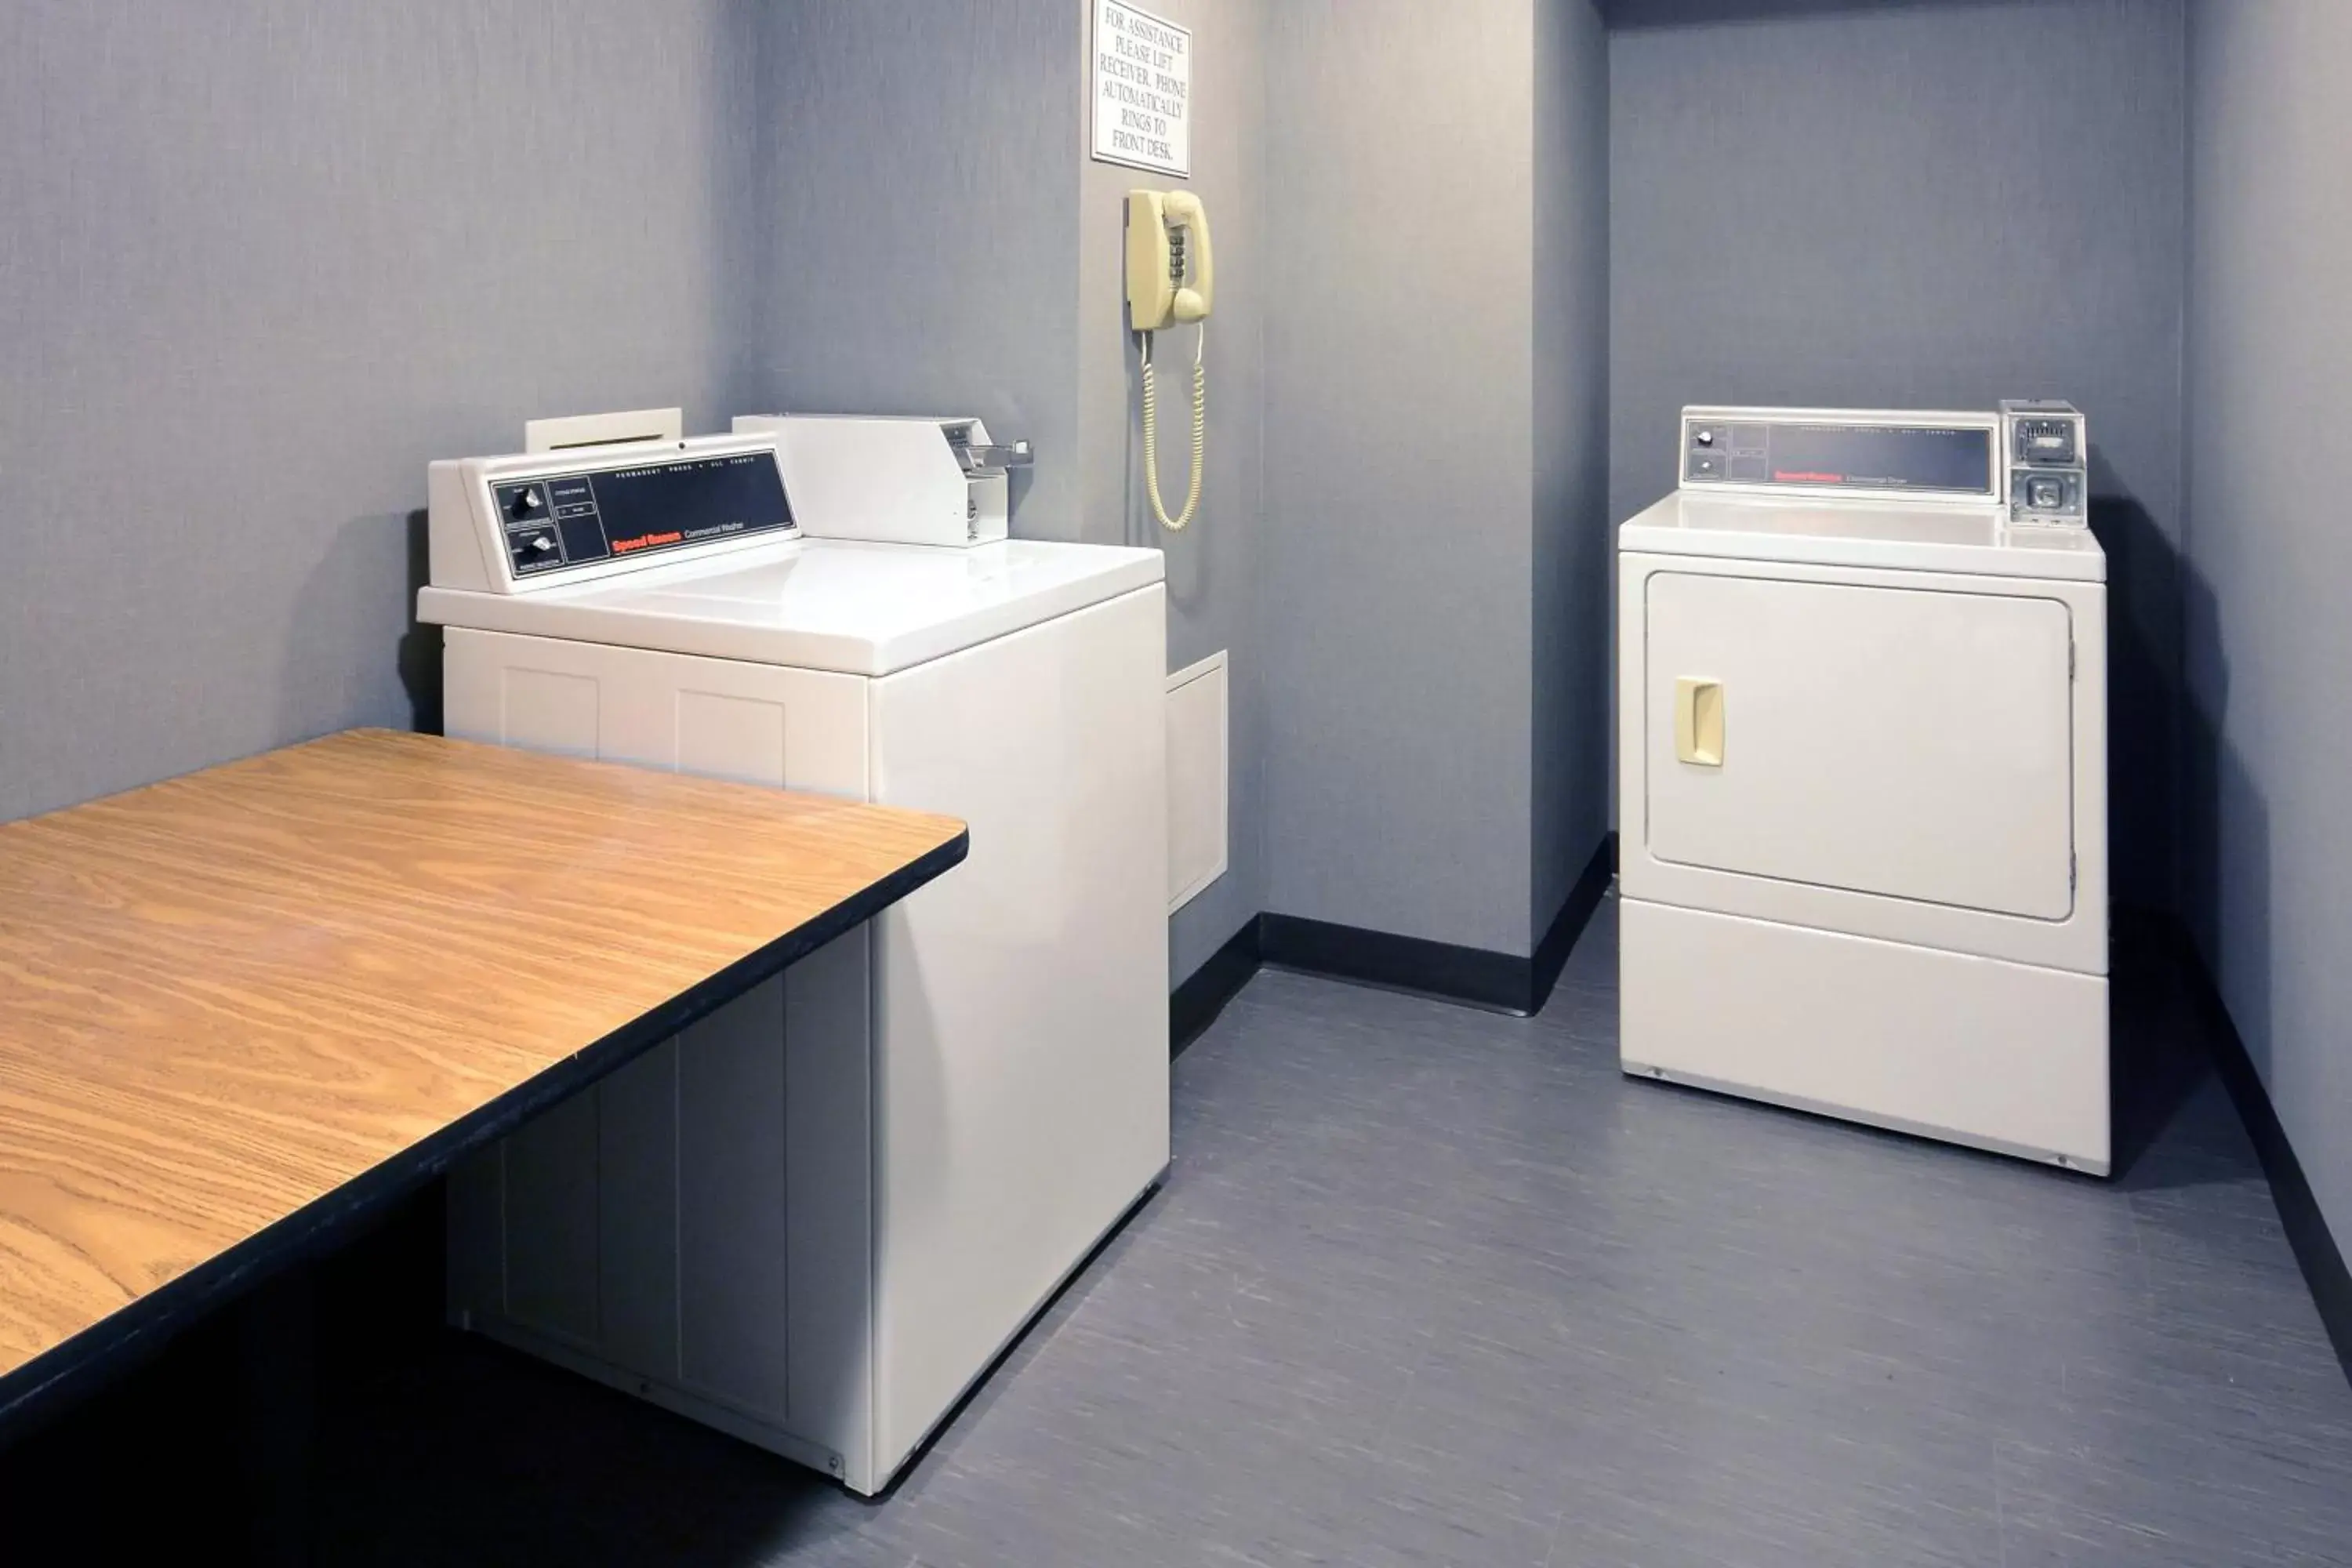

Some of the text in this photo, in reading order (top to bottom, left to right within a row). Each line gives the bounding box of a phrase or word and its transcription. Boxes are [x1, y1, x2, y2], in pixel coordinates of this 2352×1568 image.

[1105, 6, 1184, 54] FOR ASSISTANCE
[1116, 35, 1172, 71] PLEASE LIFT
[1102, 80, 1182, 118] AUTOMATICALLY
[1156, 73, 1185, 98] PHONE
[1122, 108, 1167, 136] RINGS TO
[1112, 129, 1145, 154] FRONT
